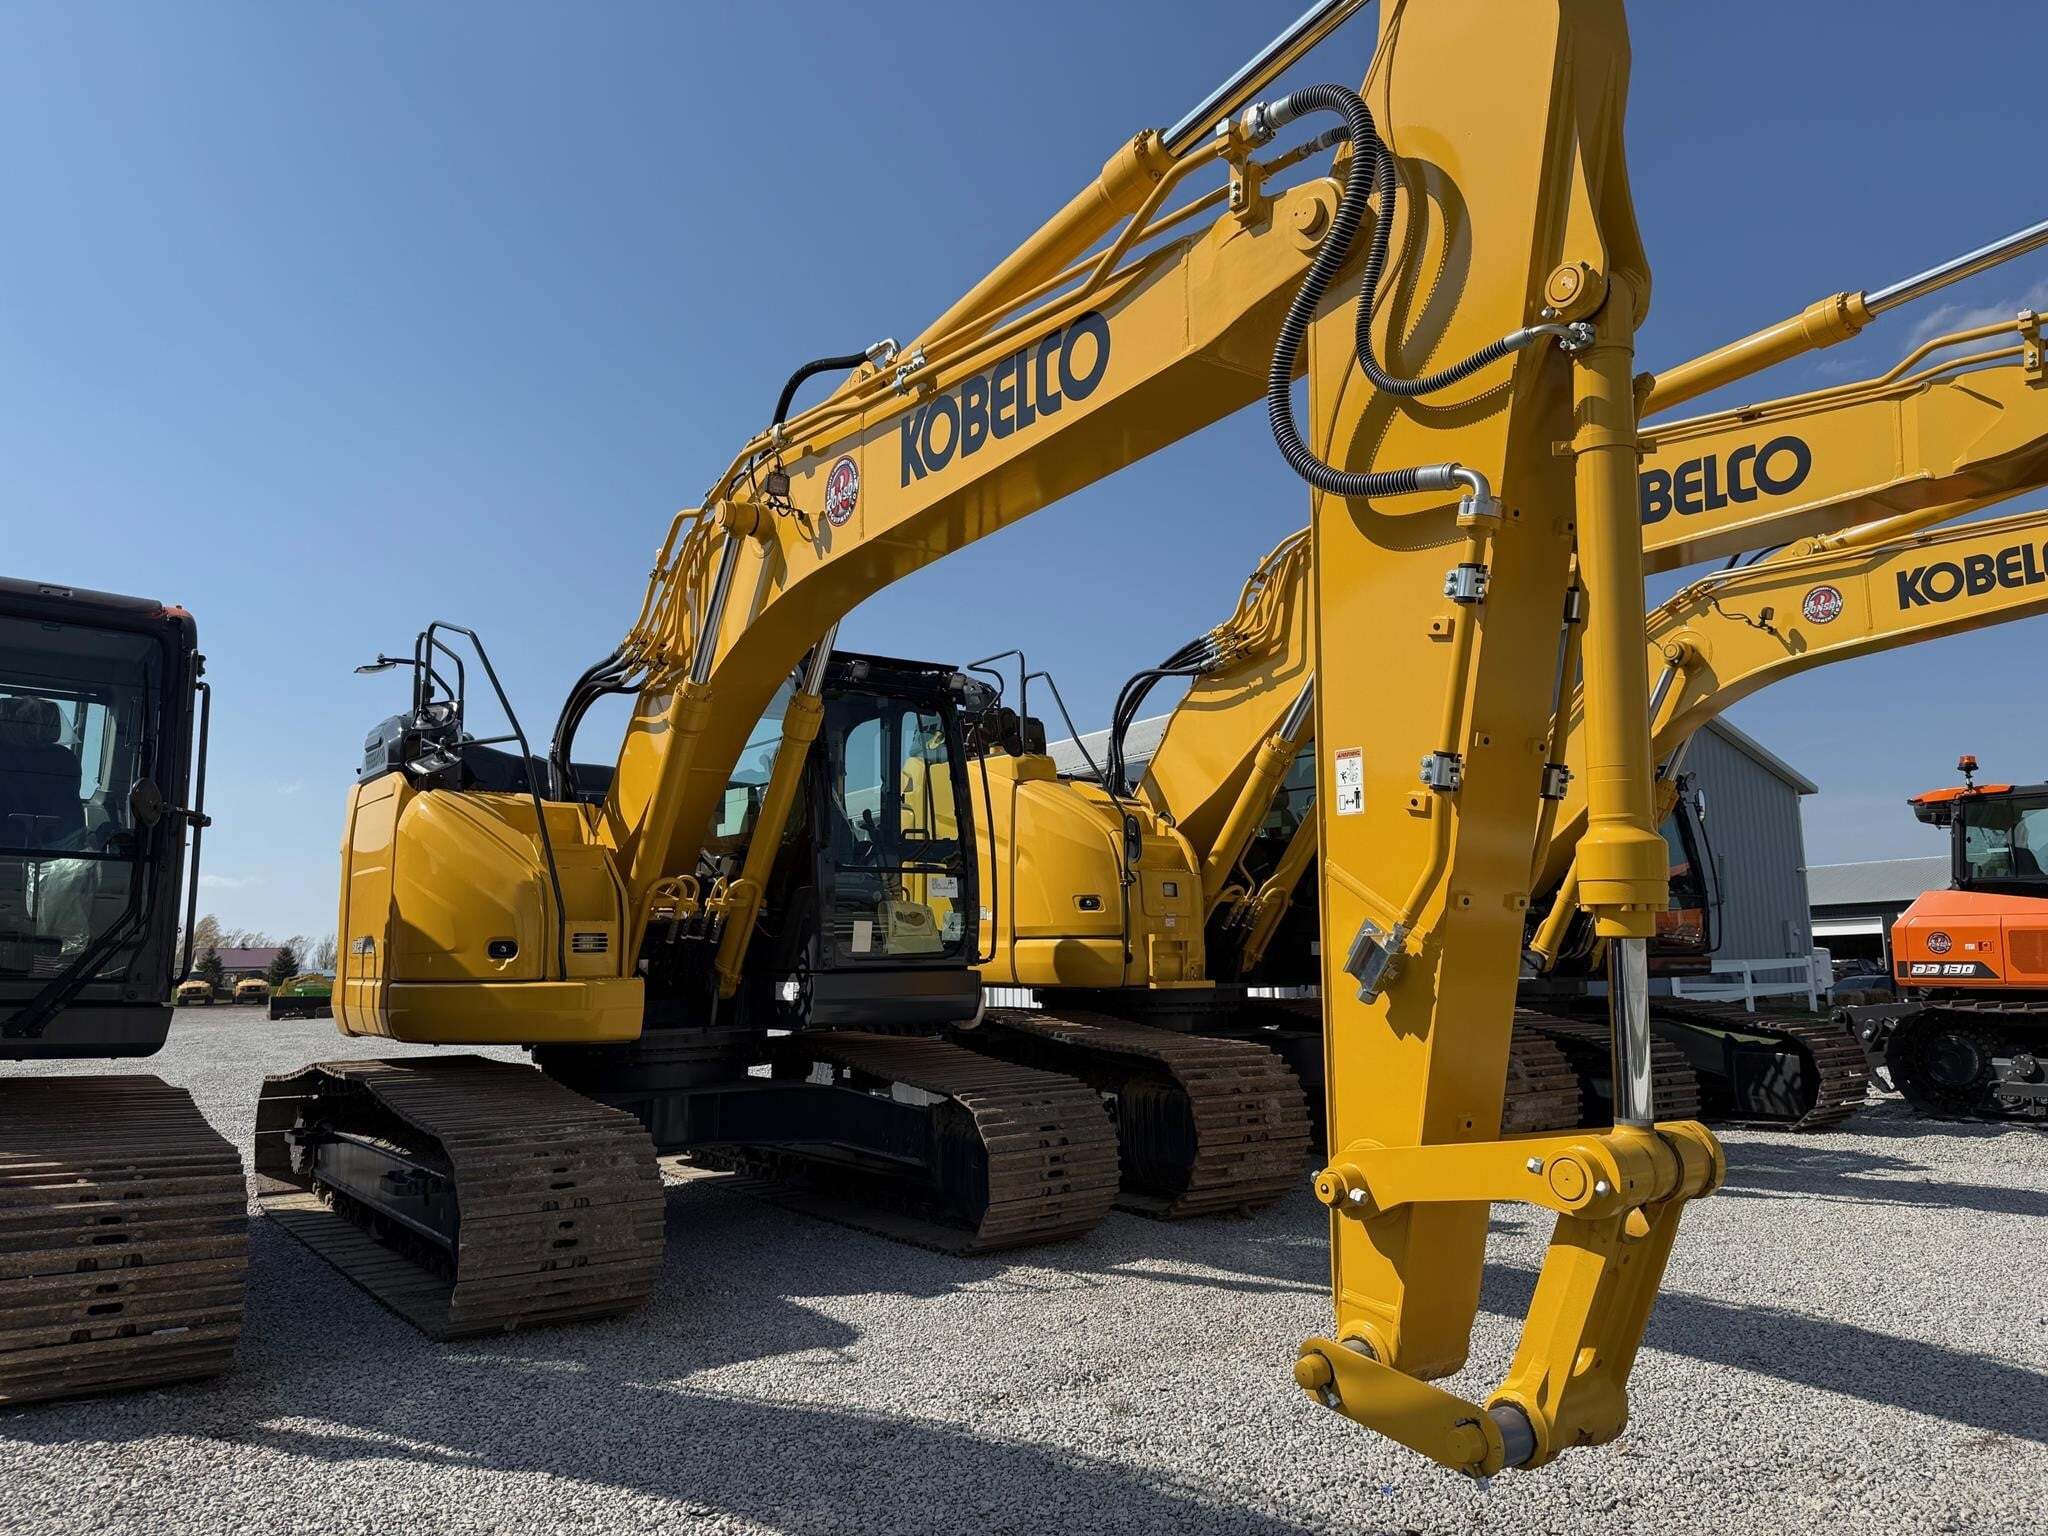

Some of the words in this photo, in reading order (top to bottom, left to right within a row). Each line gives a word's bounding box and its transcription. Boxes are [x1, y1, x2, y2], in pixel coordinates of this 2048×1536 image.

[901, 311, 1111, 488] KOBELCO
[1639, 436, 1812, 525] BELCO
[1896, 540, 2048, 610] KOBEL
[1911, 963, 1941, 975] DD
[1943, 963, 1976, 975] 130
